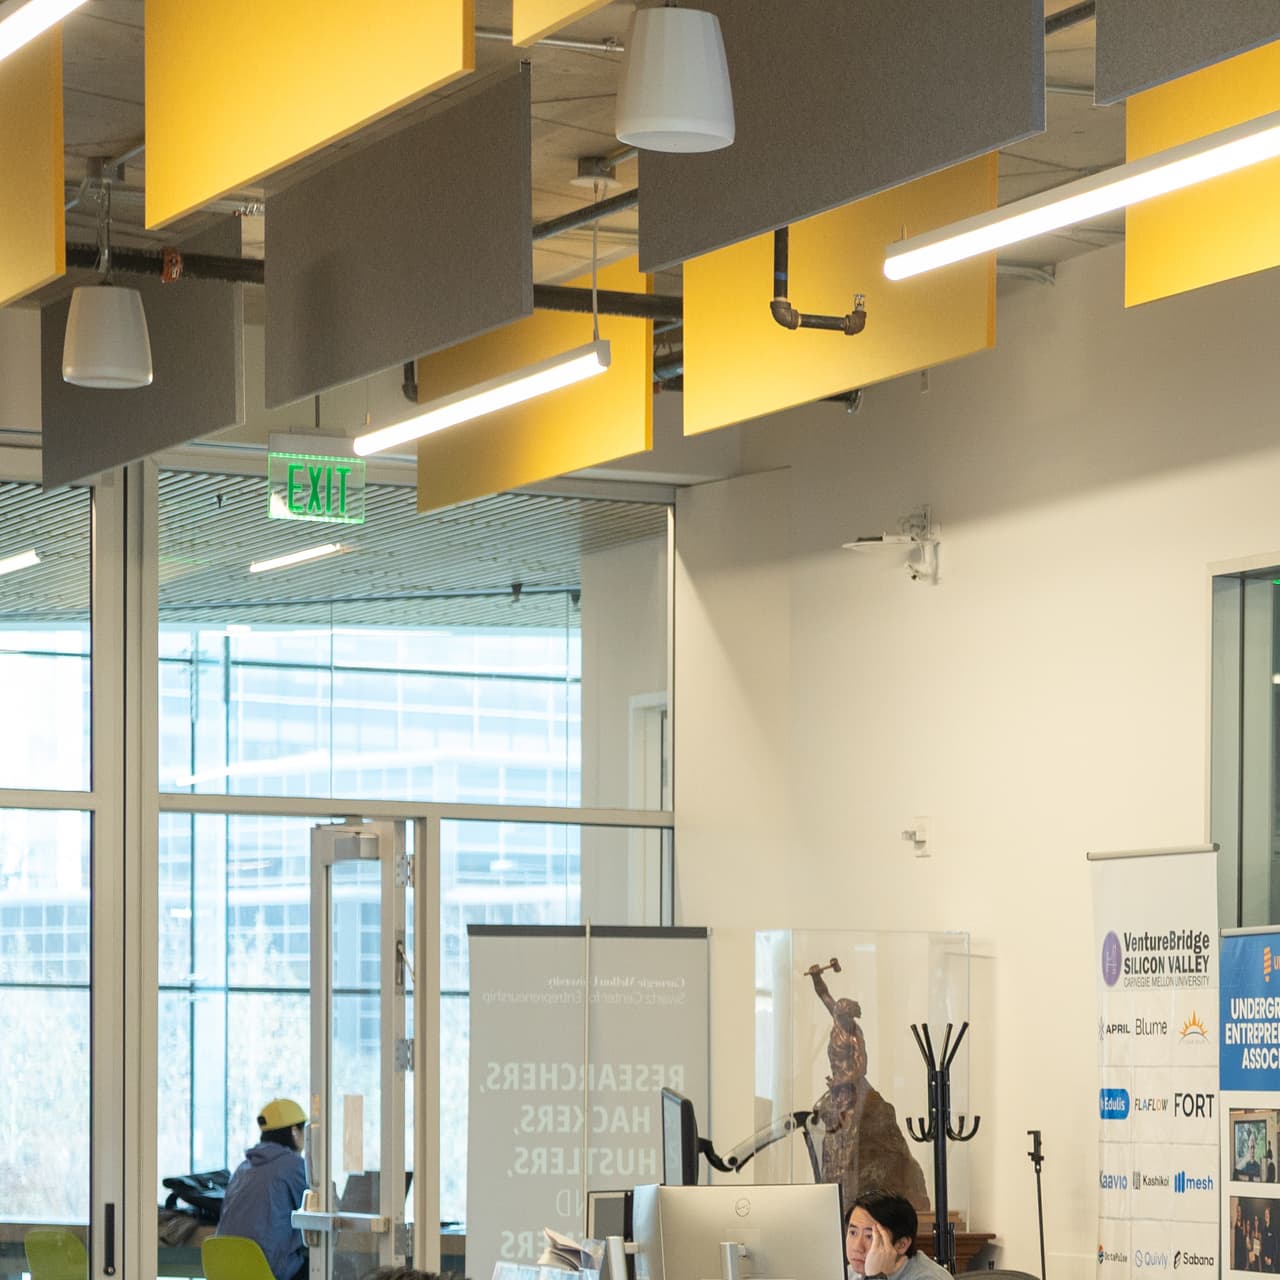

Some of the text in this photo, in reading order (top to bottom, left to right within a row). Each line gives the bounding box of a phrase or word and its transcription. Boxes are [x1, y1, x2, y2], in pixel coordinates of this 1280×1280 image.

[287, 463, 352, 515] EXIT
[1123, 929, 1210, 954] VentureBridge
[1123, 955, 1165, 975] SILICON
[1168, 954, 1210, 974] VALLEY
[1174, 975, 1210, 987] UNIVERSITY
[1106, 1023, 1131, 1035] APRIL
[1135, 1017, 1168, 1036] Blume
[1104, 1097, 1126, 1111] Edulis
[1174, 1093, 1215, 1118] FORT
[1186, 1175, 1214, 1190] mesh
[1183, 1251, 1215, 1266] Sabana
